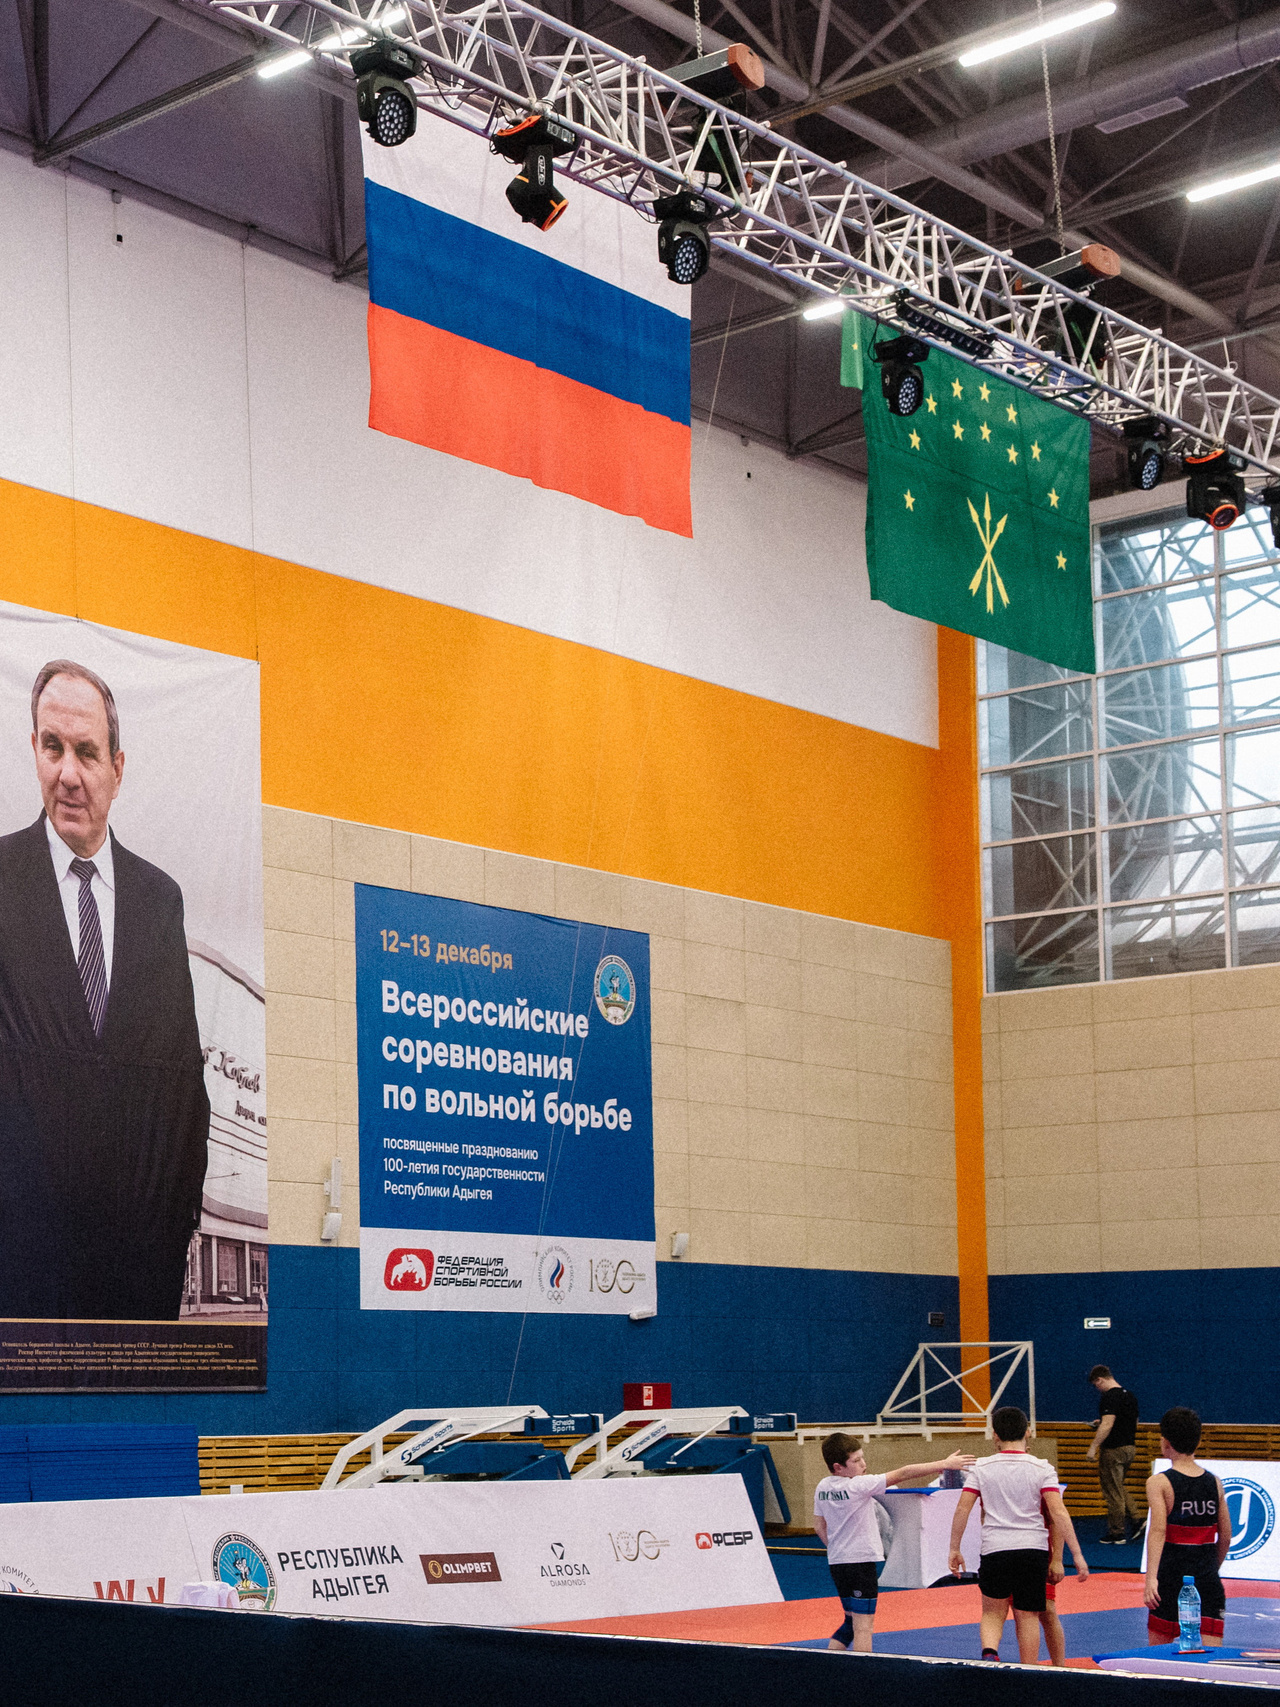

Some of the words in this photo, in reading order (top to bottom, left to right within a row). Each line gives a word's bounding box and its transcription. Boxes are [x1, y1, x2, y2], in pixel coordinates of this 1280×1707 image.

[435, 942, 513, 974] декабря
[381, 979, 589, 1039] Всероссийские
[381, 1035, 573, 1081] соревнования
[383, 1083, 417, 1112] по
[425, 1087, 536, 1123] вольной
[543, 1091, 632, 1136] борьбе
[383, 1137, 460, 1154] посвященные
[461, 1143, 539, 1160] празднованию
[383, 1157, 440, 1175] 100-летия
[442, 1164, 545, 1182] государственности
[384, 1180, 450, 1200] Республики
[452, 1184, 493, 1202] Адыгея
[435, 1266, 509, 1278] СПОРТИВНОЙ
[437, 1255, 504, 1267] ФЕДЕРАЦИЯ
[433, 1276, 479, 1288] БОРЬБЫ
[479, 1278, 523, 1289] РОССИИ
[552, 1425, 575, 1434] Sports
[1181, 1499, 1217, 1516] RUS
[711, 1530, 754, 1547] ФСБР
[277, 1544, 404, 1572] РЕСПУБЛИКА
[442, 1561, 492, 1575] OLIMPBET
[1, 1565, 36, 1588] КОМИТЕТ
[540, 1563, 591, 1578] ALROSA
[312, 1574, 390, 1602] АДЫГЕЯ
[549, 1578, 586, 1587] DIAMONDS
